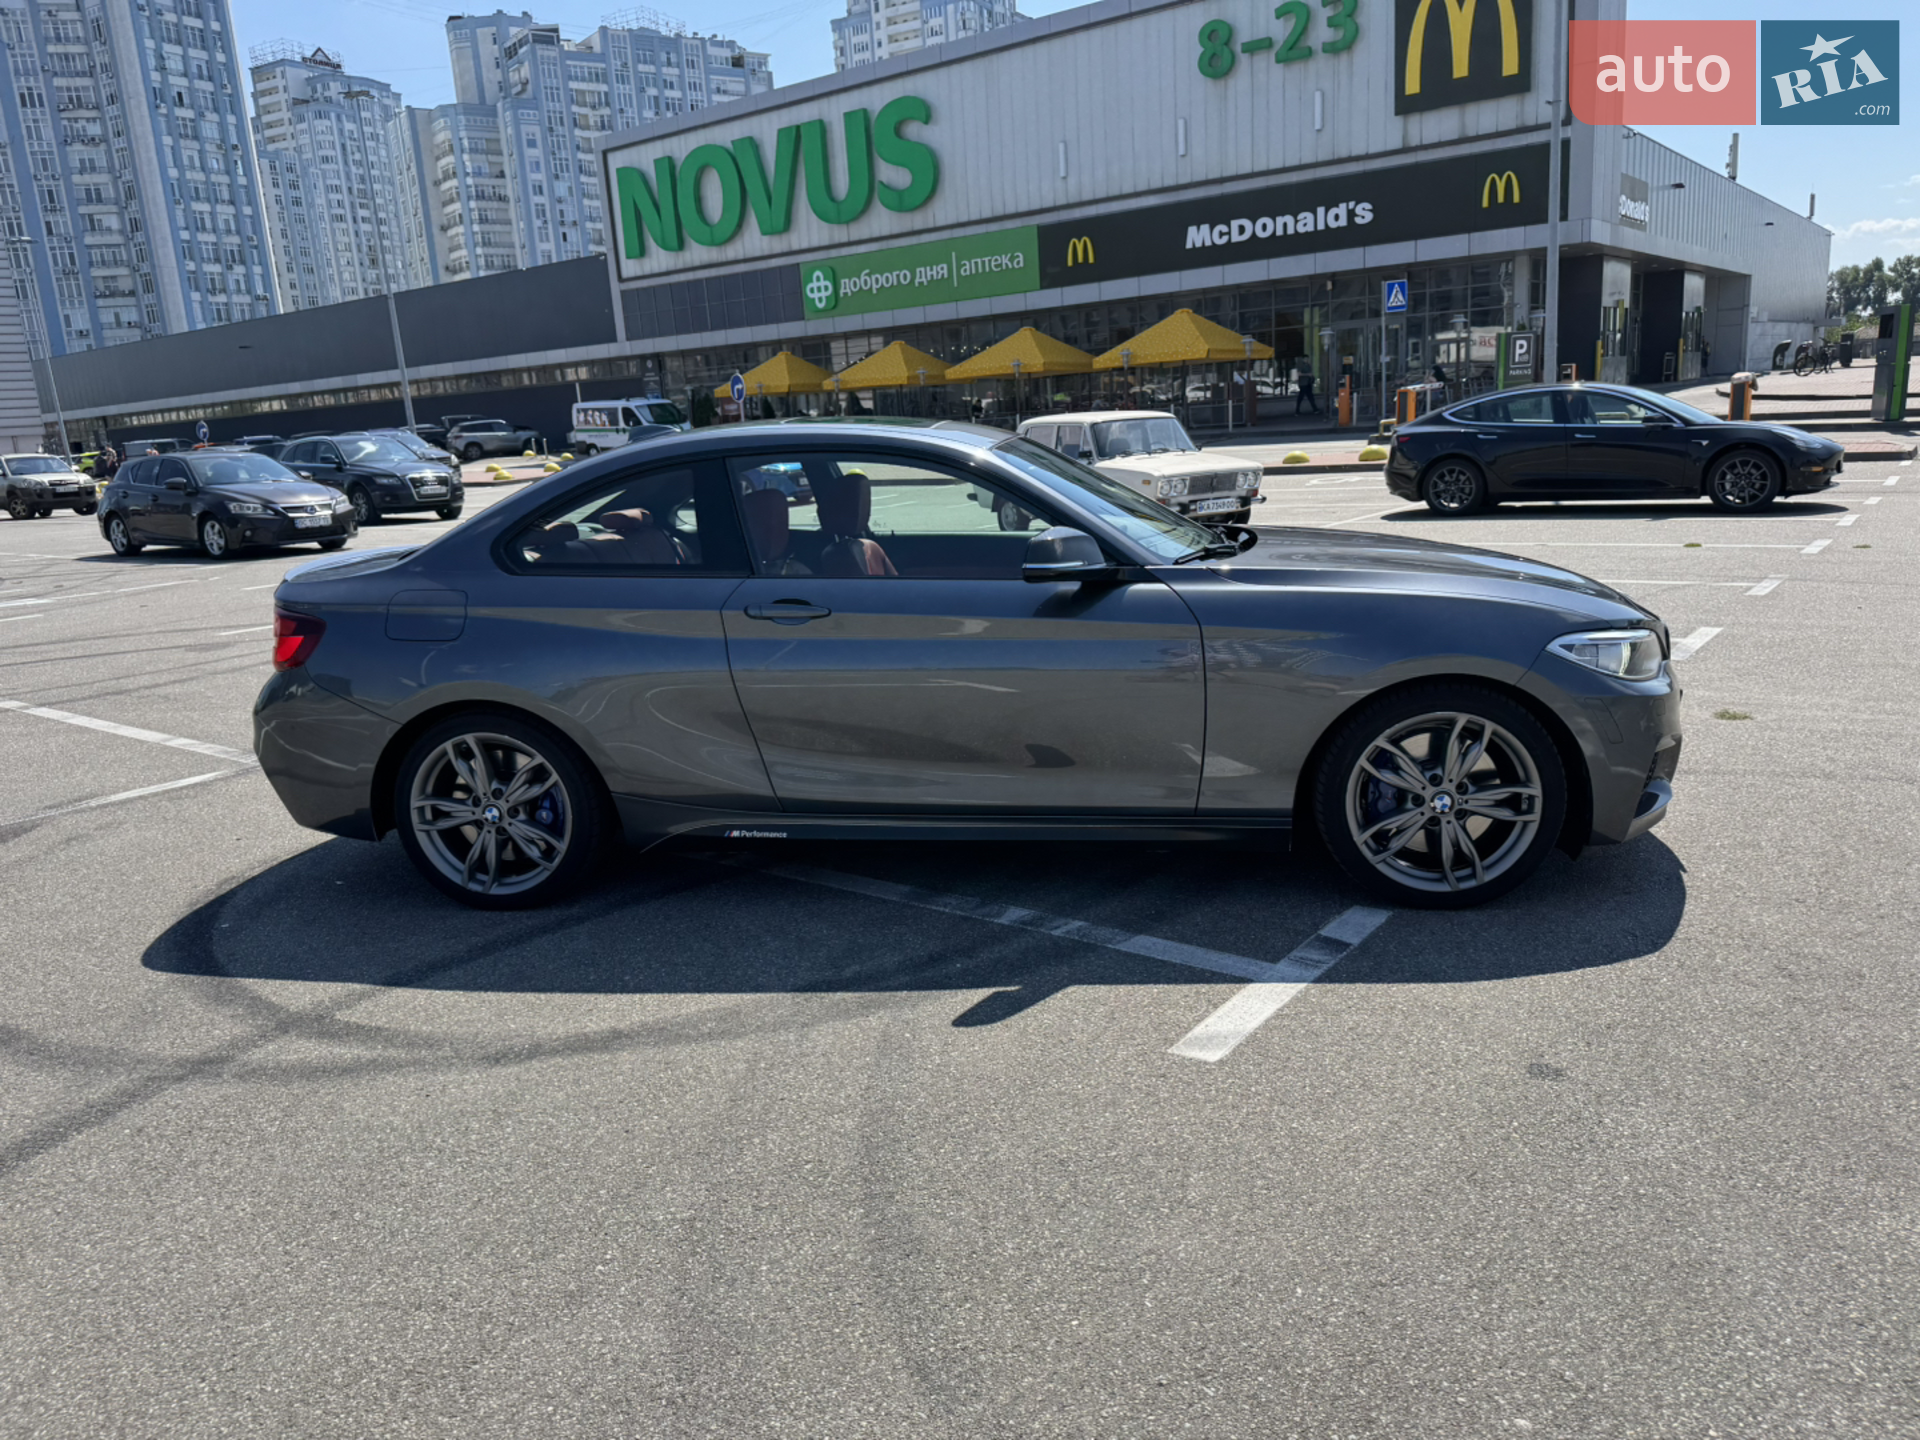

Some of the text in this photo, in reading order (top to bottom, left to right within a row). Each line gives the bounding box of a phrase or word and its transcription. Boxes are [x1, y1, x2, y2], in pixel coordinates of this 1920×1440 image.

[616, 95, 938, 259] NOVUS
[1185, 201, 1374, 249] McDonald's
[840, 252, 1024, 297] доброго дня аптека
[1515, 340, 1528, 362] P
[741, 830, 788, 838] Performance
